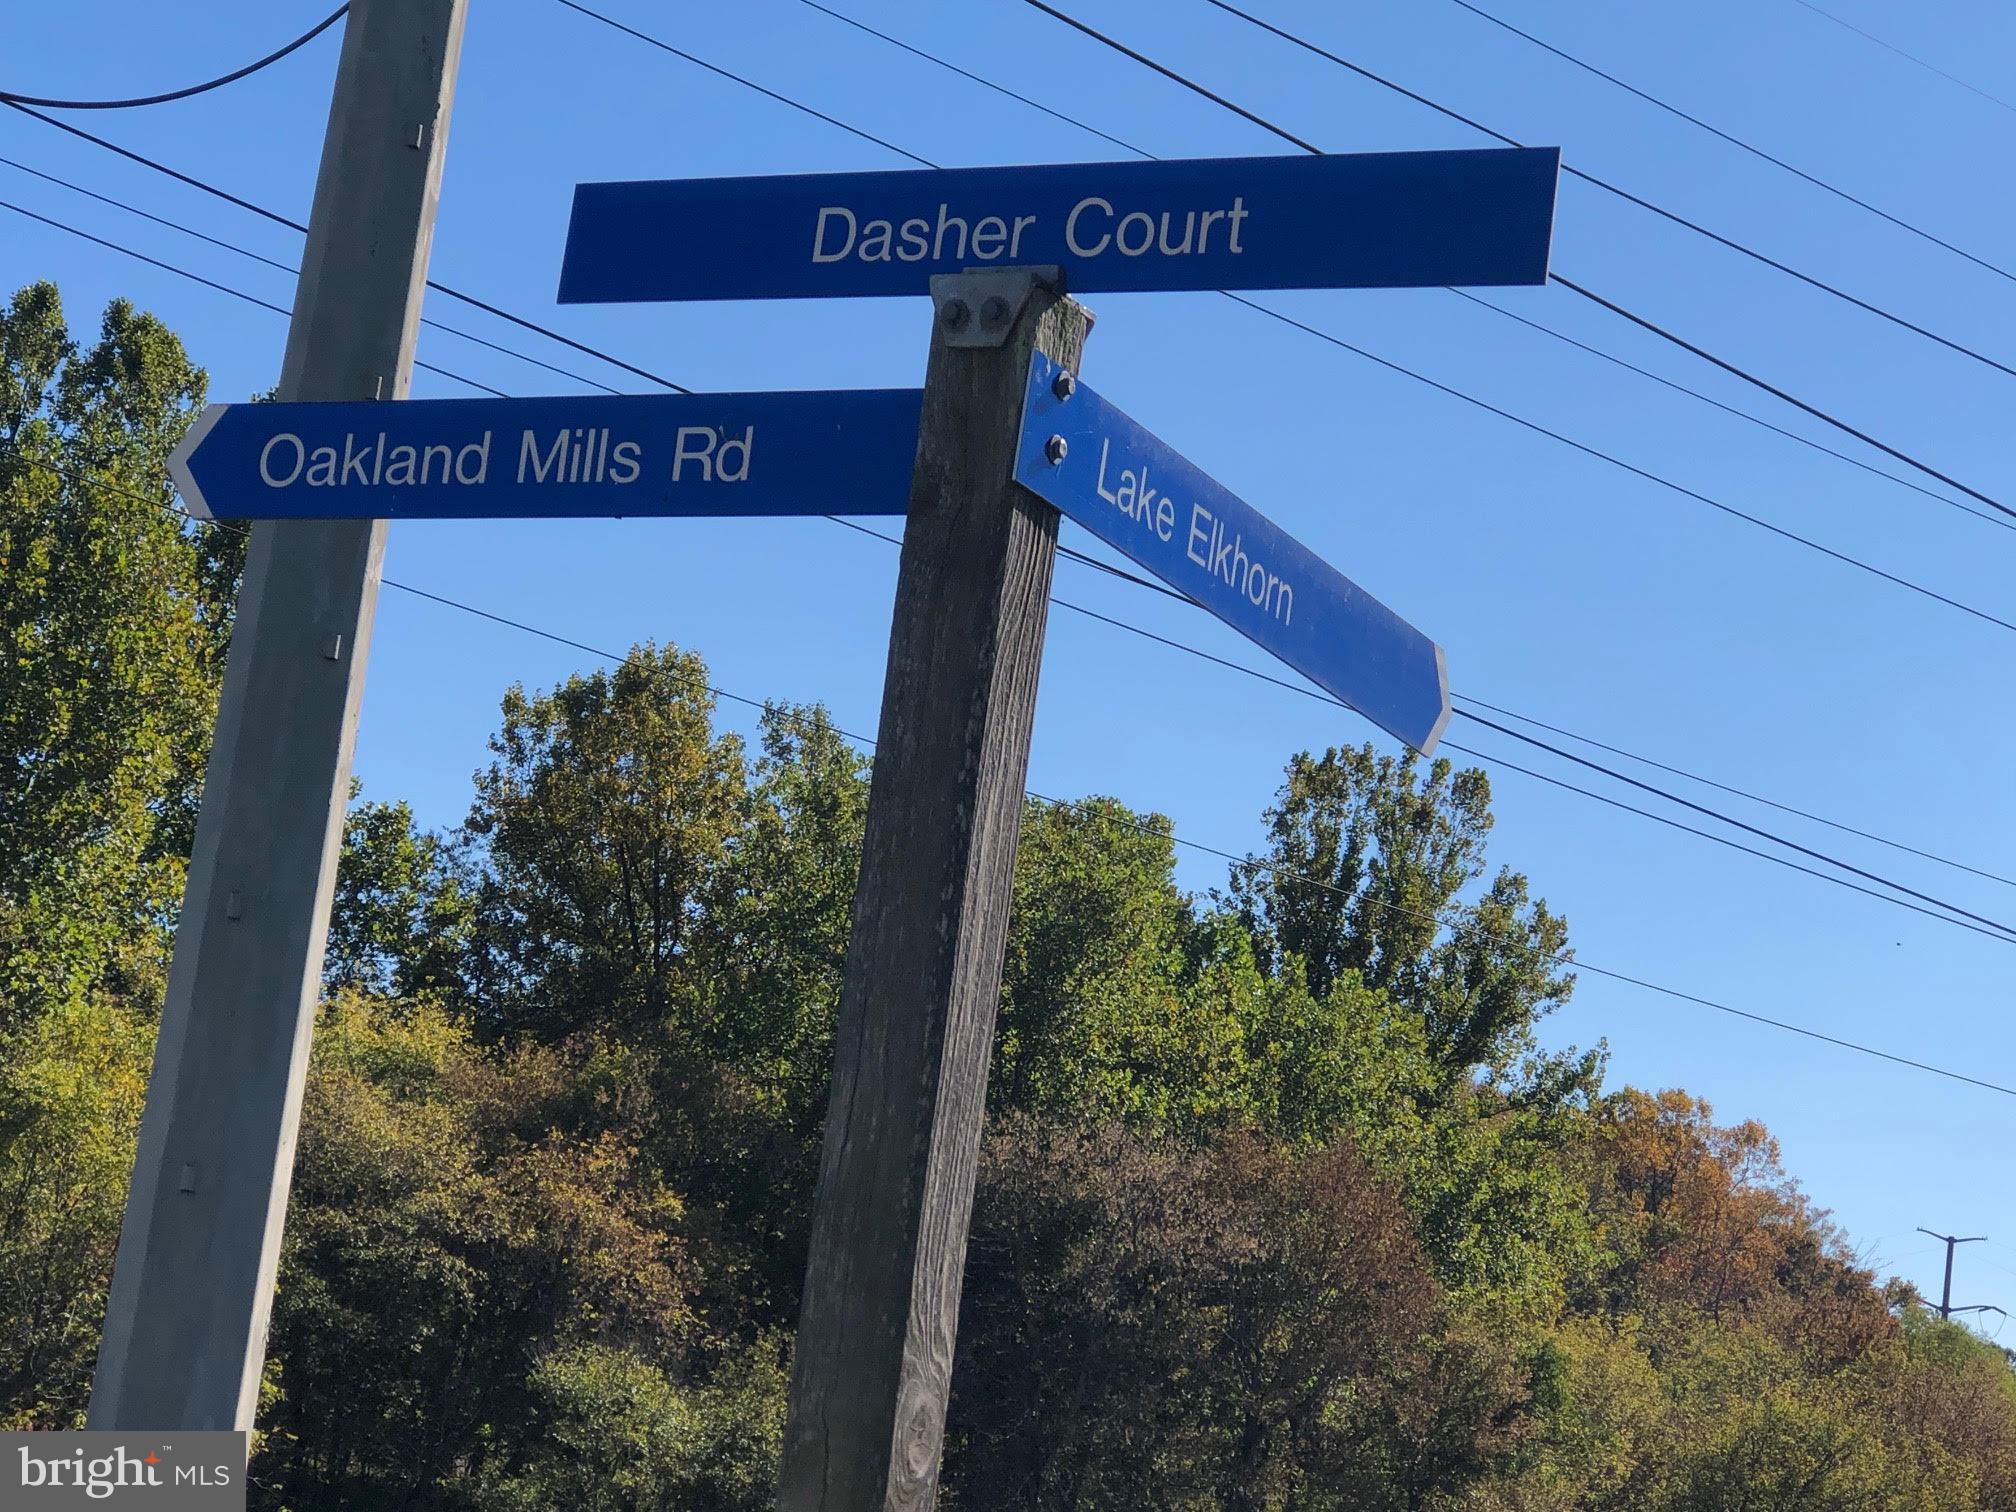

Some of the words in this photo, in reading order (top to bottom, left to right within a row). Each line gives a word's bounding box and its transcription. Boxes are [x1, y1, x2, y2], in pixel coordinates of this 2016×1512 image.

[811, 203, 1037, 265] Dasher
[1065, 196, 1248, 258] Court
[258, 430, 493, 488] Oakland
[515, 427, 642, 485] Mills
[671, 425, 754, 483] Rd
[1096, 437, 1176, 542] Lake
[1186, 502, 1293, 626] Elkhorn
